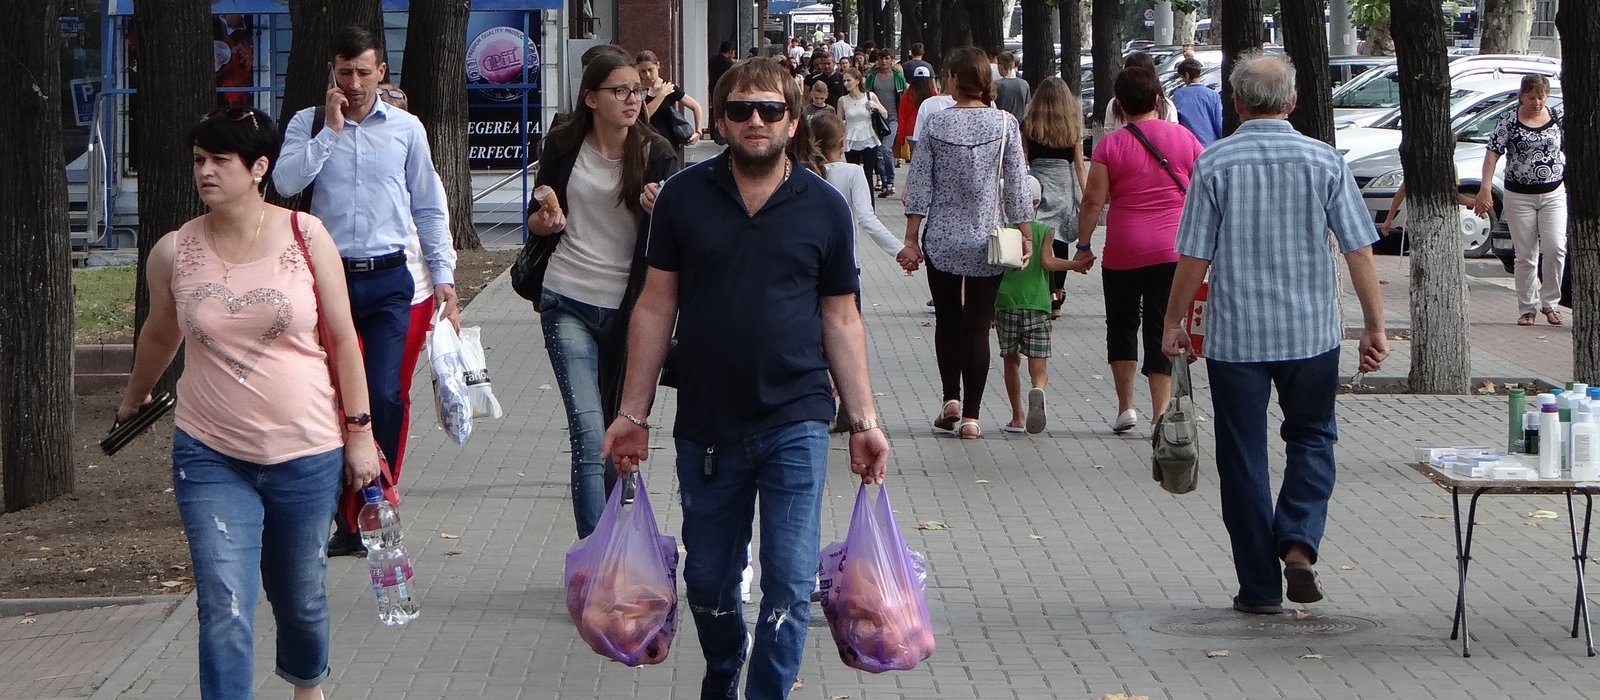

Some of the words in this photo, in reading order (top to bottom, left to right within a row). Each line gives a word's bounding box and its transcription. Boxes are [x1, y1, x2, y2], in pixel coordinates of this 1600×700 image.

[481, 29, 504, 40] QUALITY
[504, 28, 525, 40] PRODUC
[82, 84, 95, 102] P
